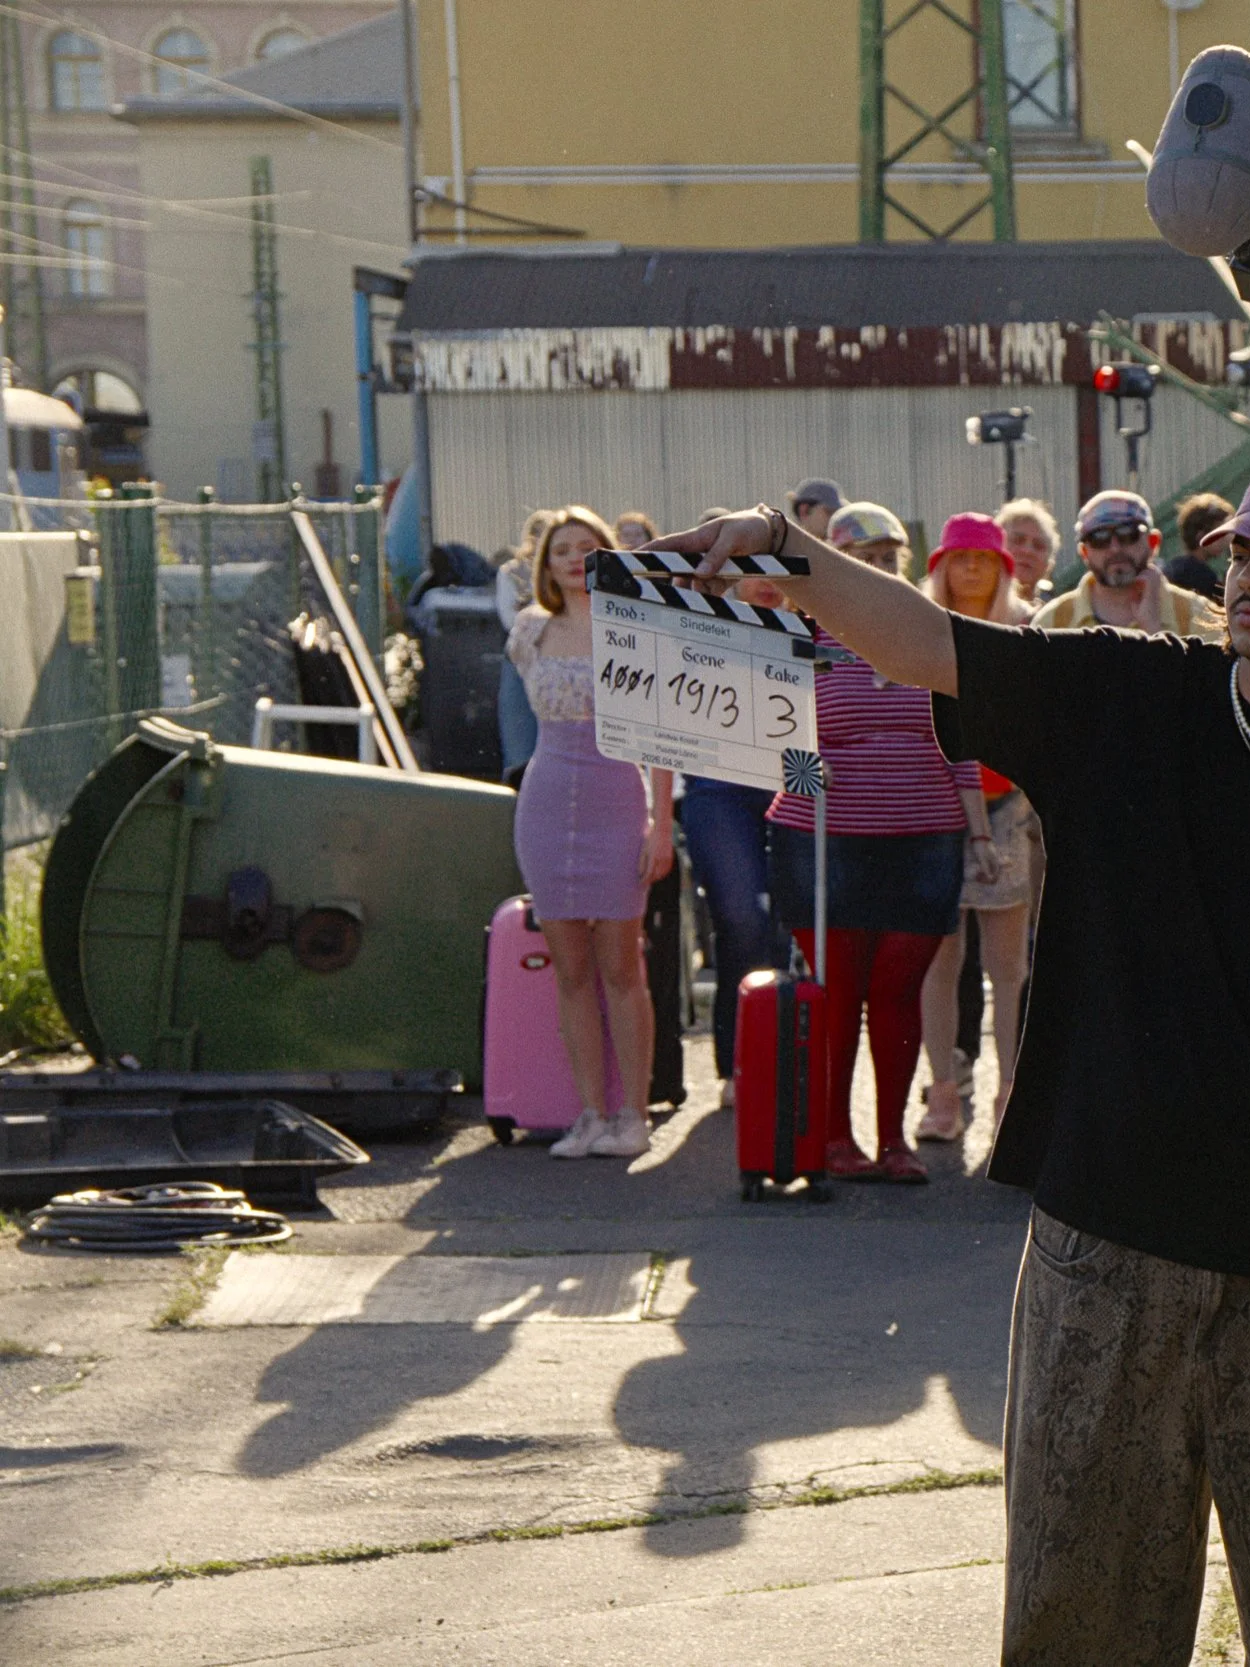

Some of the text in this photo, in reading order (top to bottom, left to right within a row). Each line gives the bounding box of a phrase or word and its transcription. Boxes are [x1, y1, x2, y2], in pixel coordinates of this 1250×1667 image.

[679, 616, 731, 638] Sindefekt
[605, 629, 637, 650] Roll
[681, 646, 726, 669] Scene
[764, 663, 801, 686] Take
[765, 694, 798, 738] 3
